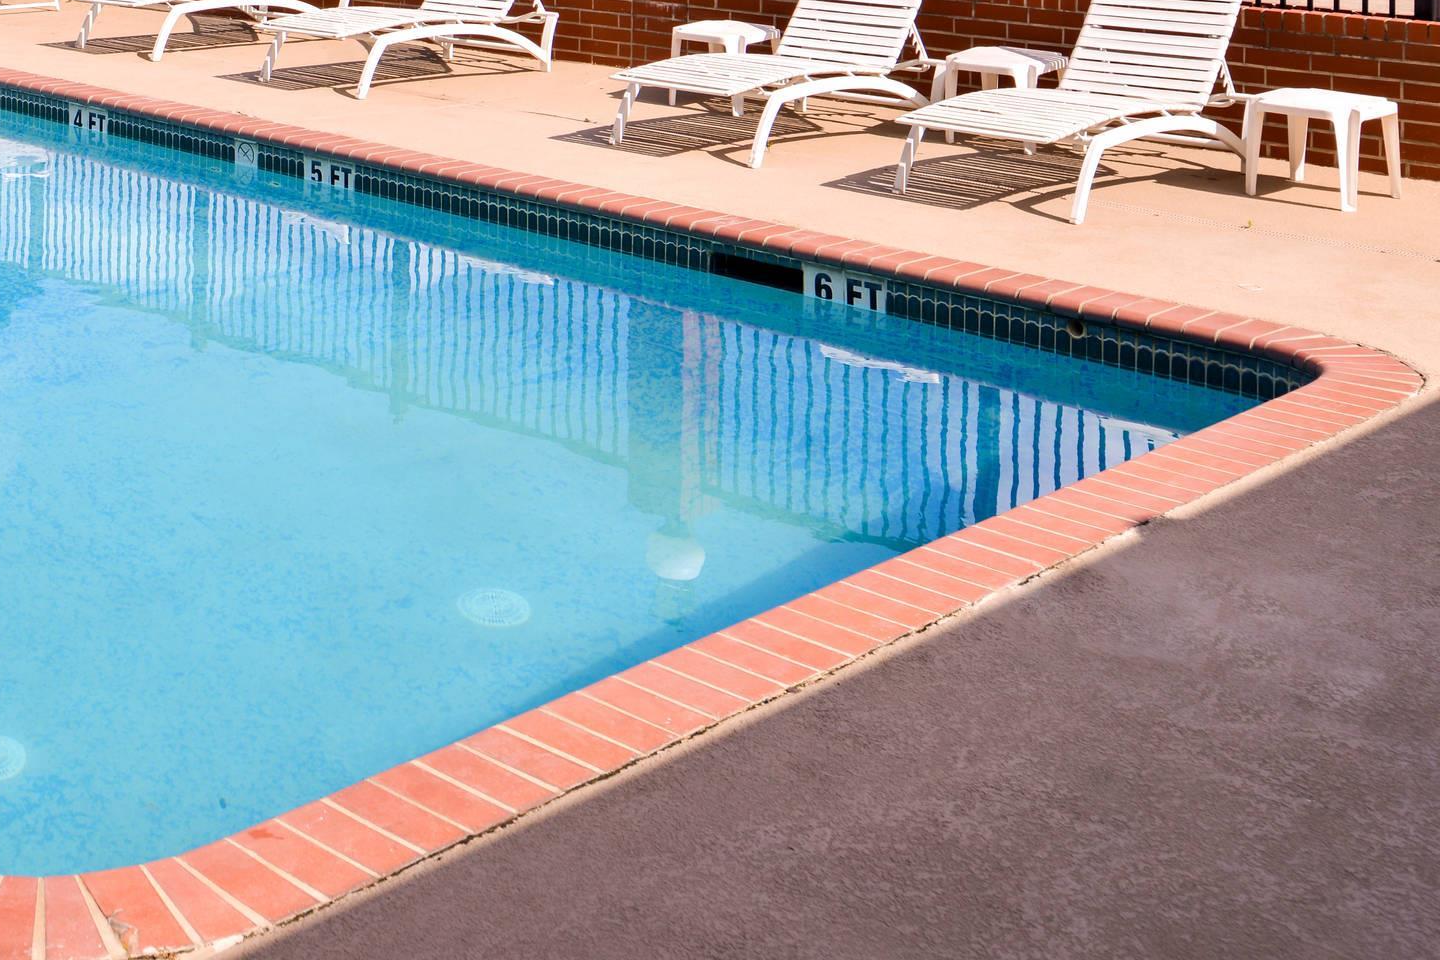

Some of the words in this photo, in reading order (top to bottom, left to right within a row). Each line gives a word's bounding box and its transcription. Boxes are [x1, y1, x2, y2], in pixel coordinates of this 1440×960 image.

[74, 110, 83, 127] 4
[89, 112, 106, 132] FT
[311, 160, 322, 182] 5
[330, 164, 352, 189] FT
[815, 273, 832, 300] 6
[847, 278, 882, 310] FT
